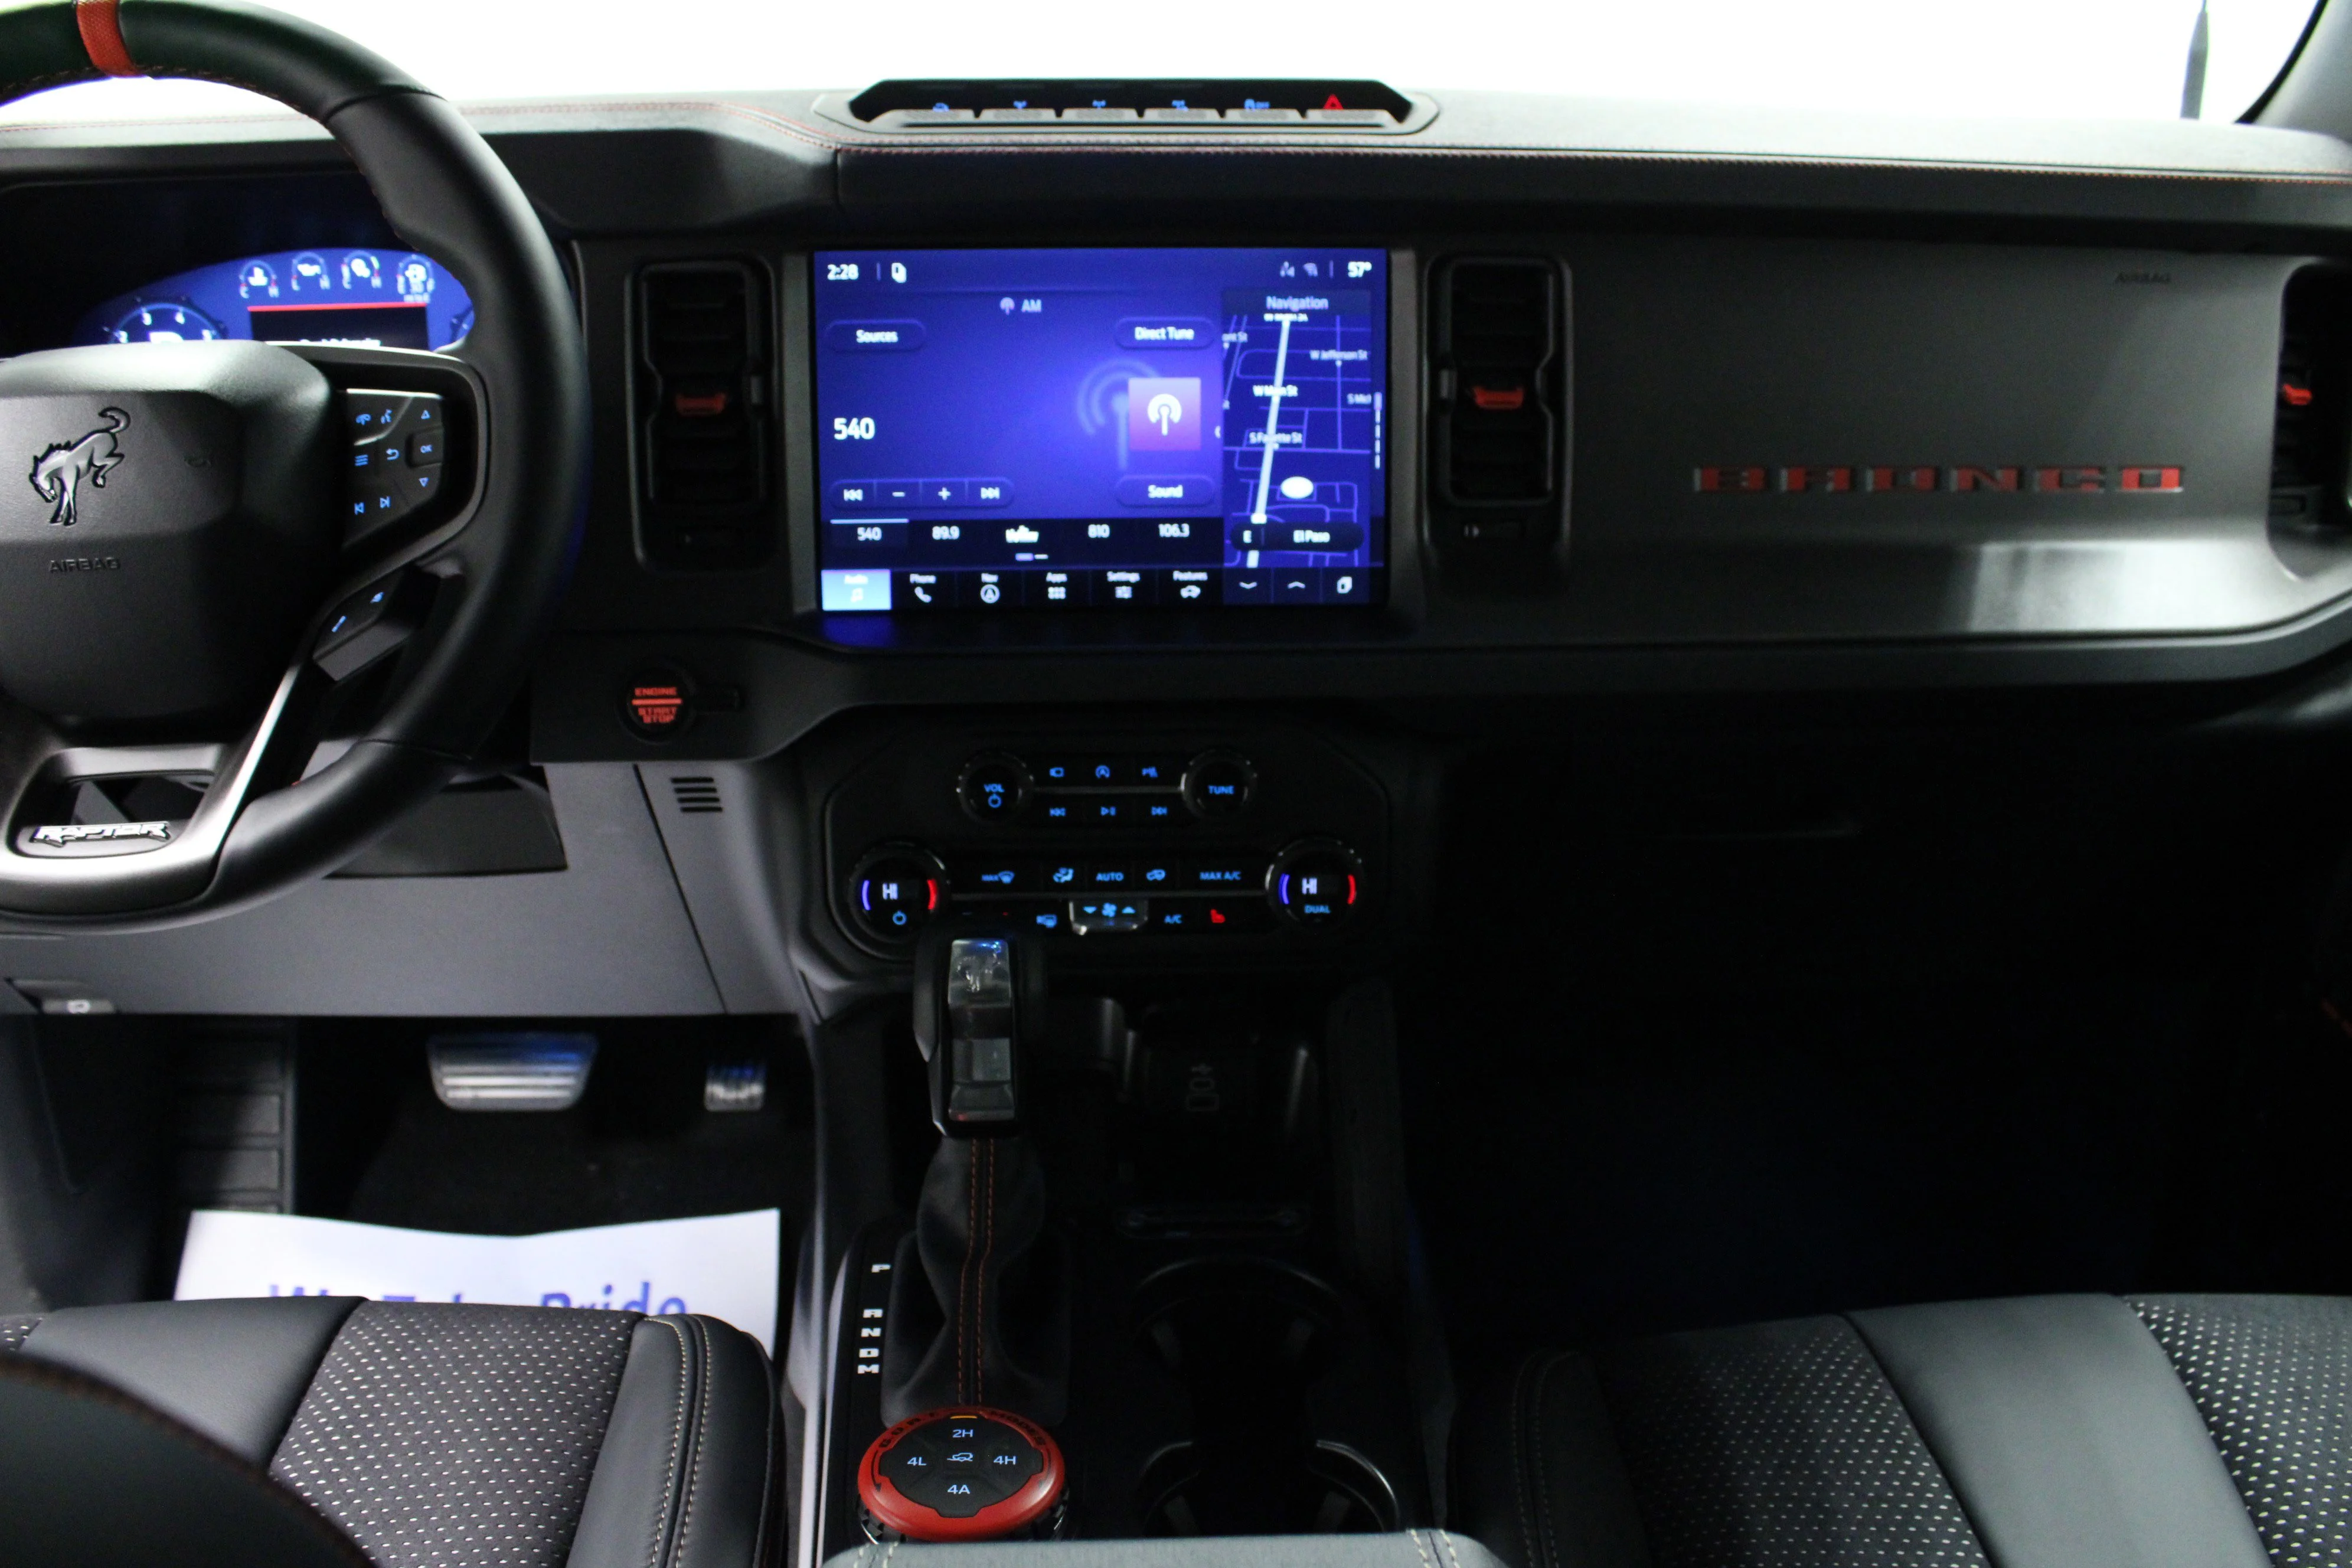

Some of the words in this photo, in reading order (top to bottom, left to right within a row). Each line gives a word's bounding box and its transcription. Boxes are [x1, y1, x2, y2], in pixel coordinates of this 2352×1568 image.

[827, 263, 858, 280] 2:28
[1021, 299, 1042, 313] AM
[1266, 296, 1328, 312] Navigation
[856, 328, 898, 343] Sources
[1134, 326, 1166, 341] Direct
[1167, 326, 1194, 341] Tune
[834, 417, 876, 440] 540
[420, 444, 432, 453] OK
[1148, 484, 1183, 498] Sound
[857, 527, 883, 541] 540
[932, 525, 960, 540] 89.9
[1158, 523, 1190, 538] 106.3
[49, 558, 120, 572] AIRBAG
[984, 783, 1005, 793] VOL
[1208, 785, 1235, 795] TUNE
[33, 822, 171, 844] RAPTOR
[1096, 872, 1124, 881] AUTO
[1200, 871, 1222, 880] MAX
[1223, 871, 1242, 880] A/C
[882, 883, 899, 900] HI
[1302, 878, 1318, 895] HI
[1304, 904, 1331, 914] DUAL
[1164, 914, 1182, 924] A/C
[861, 1328, 881, 1337] N
[857, 1364, 880, 1374] M
[952, 1429, 974, 1438] 2H
[907, 1456, 926, 1466] 4L
[993, 1455, 1017, 1465] 4H
[947, 1484, 971, 1494] 4A
